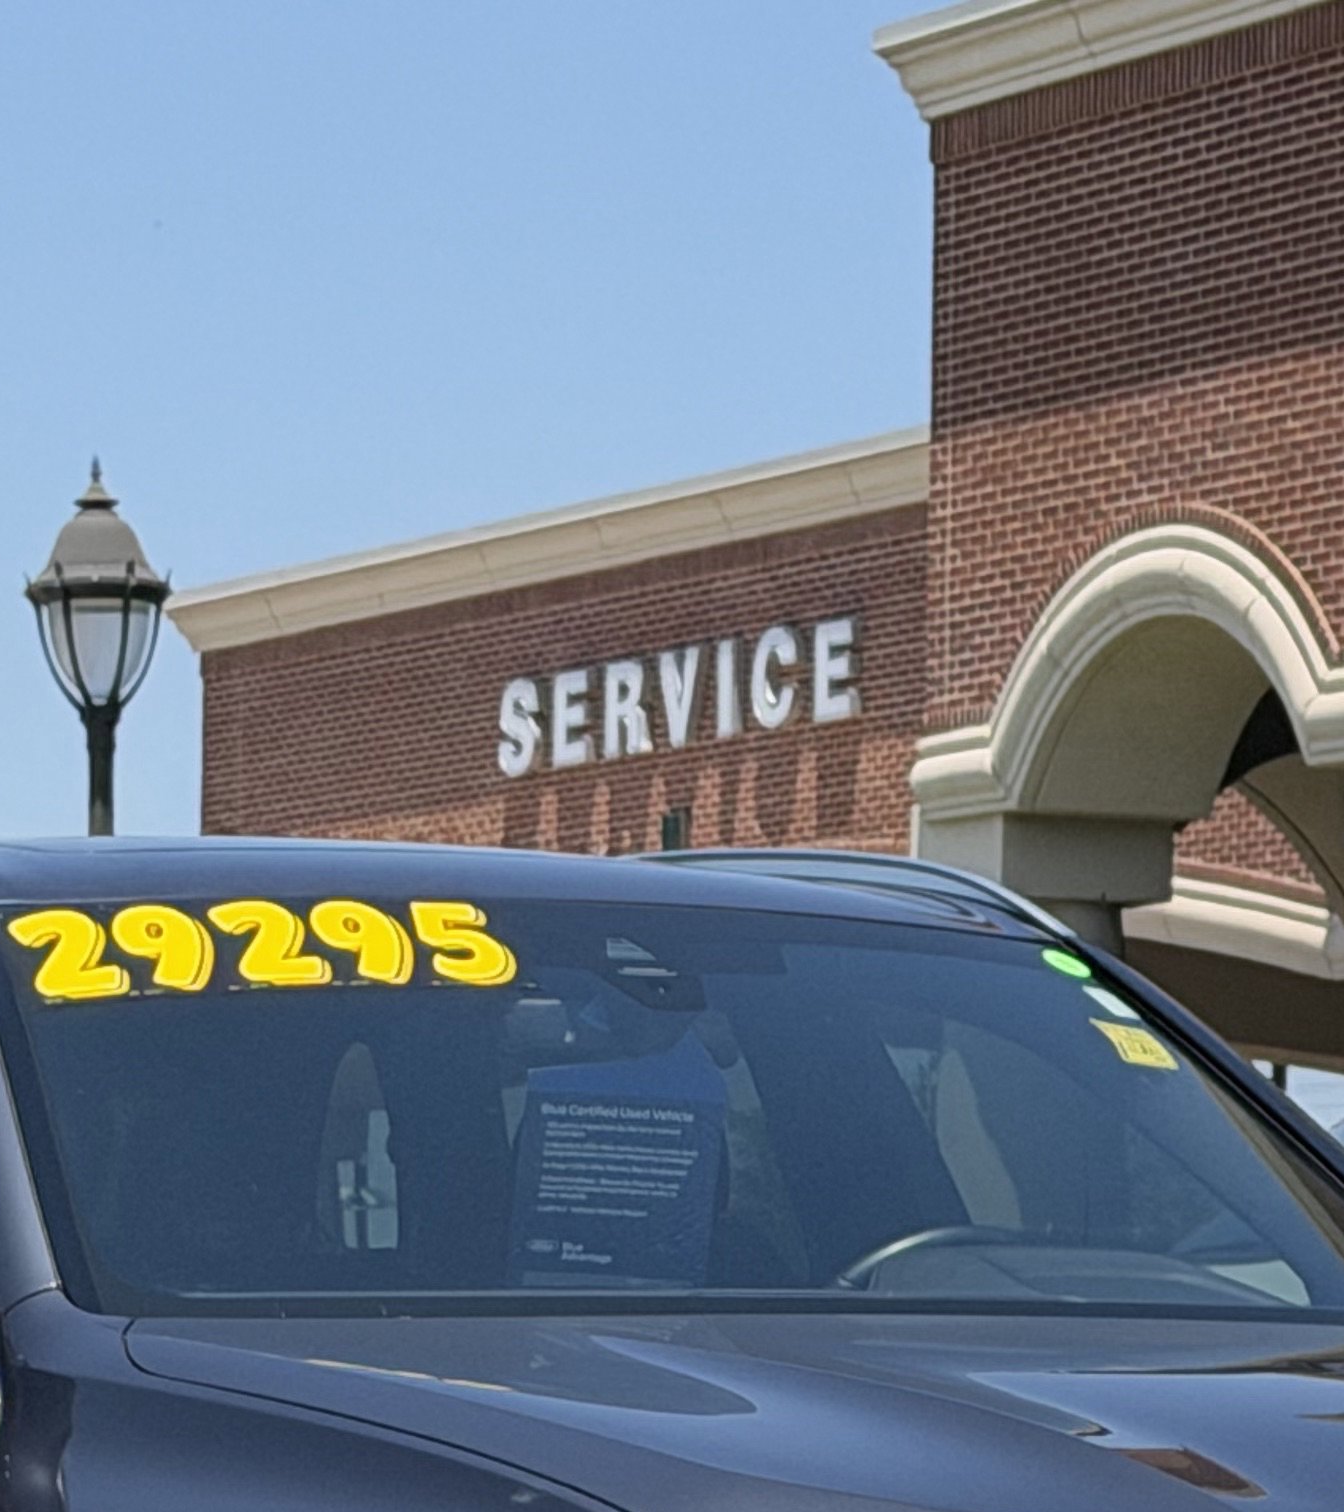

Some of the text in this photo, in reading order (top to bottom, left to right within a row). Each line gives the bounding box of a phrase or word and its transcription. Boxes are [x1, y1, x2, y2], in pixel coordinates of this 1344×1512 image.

[498, 617, 860, 778] SERVICE
[7, 900, 518, 999] 29295
[568, 1104, 618, 1119] Certified
[619, 1106, 650, 1120] Used
[651, 1108, 695, 1123] Vehicle
